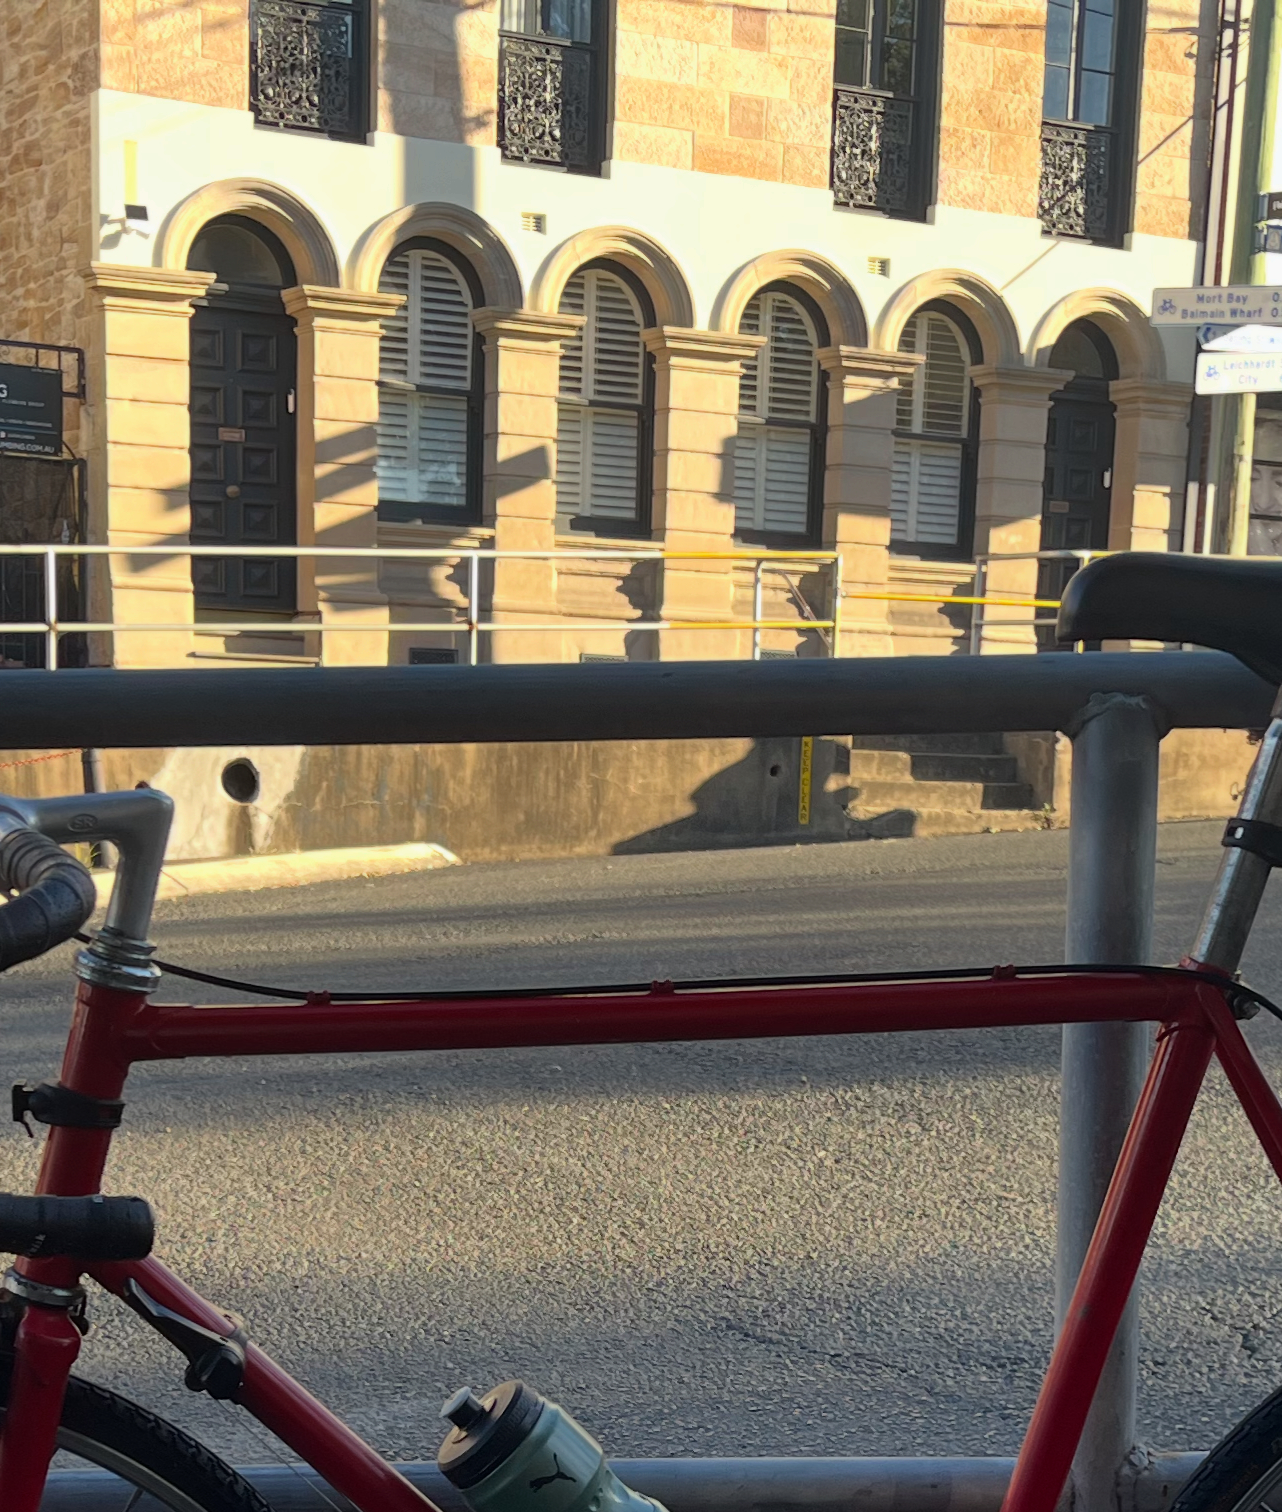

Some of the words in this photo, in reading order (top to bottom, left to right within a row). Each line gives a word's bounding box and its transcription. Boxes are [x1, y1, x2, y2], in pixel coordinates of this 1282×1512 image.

[1196, 293, 1222, 304] Mort
[1226, 293, 1249, 305] Bay
[1181, 308, 1225, 319] Balmain
[1229, 307, 1263, 318] Wharf
[1223, 359, 1275, 370] Leichhardt
[1238, 374, 1259, 385] City
